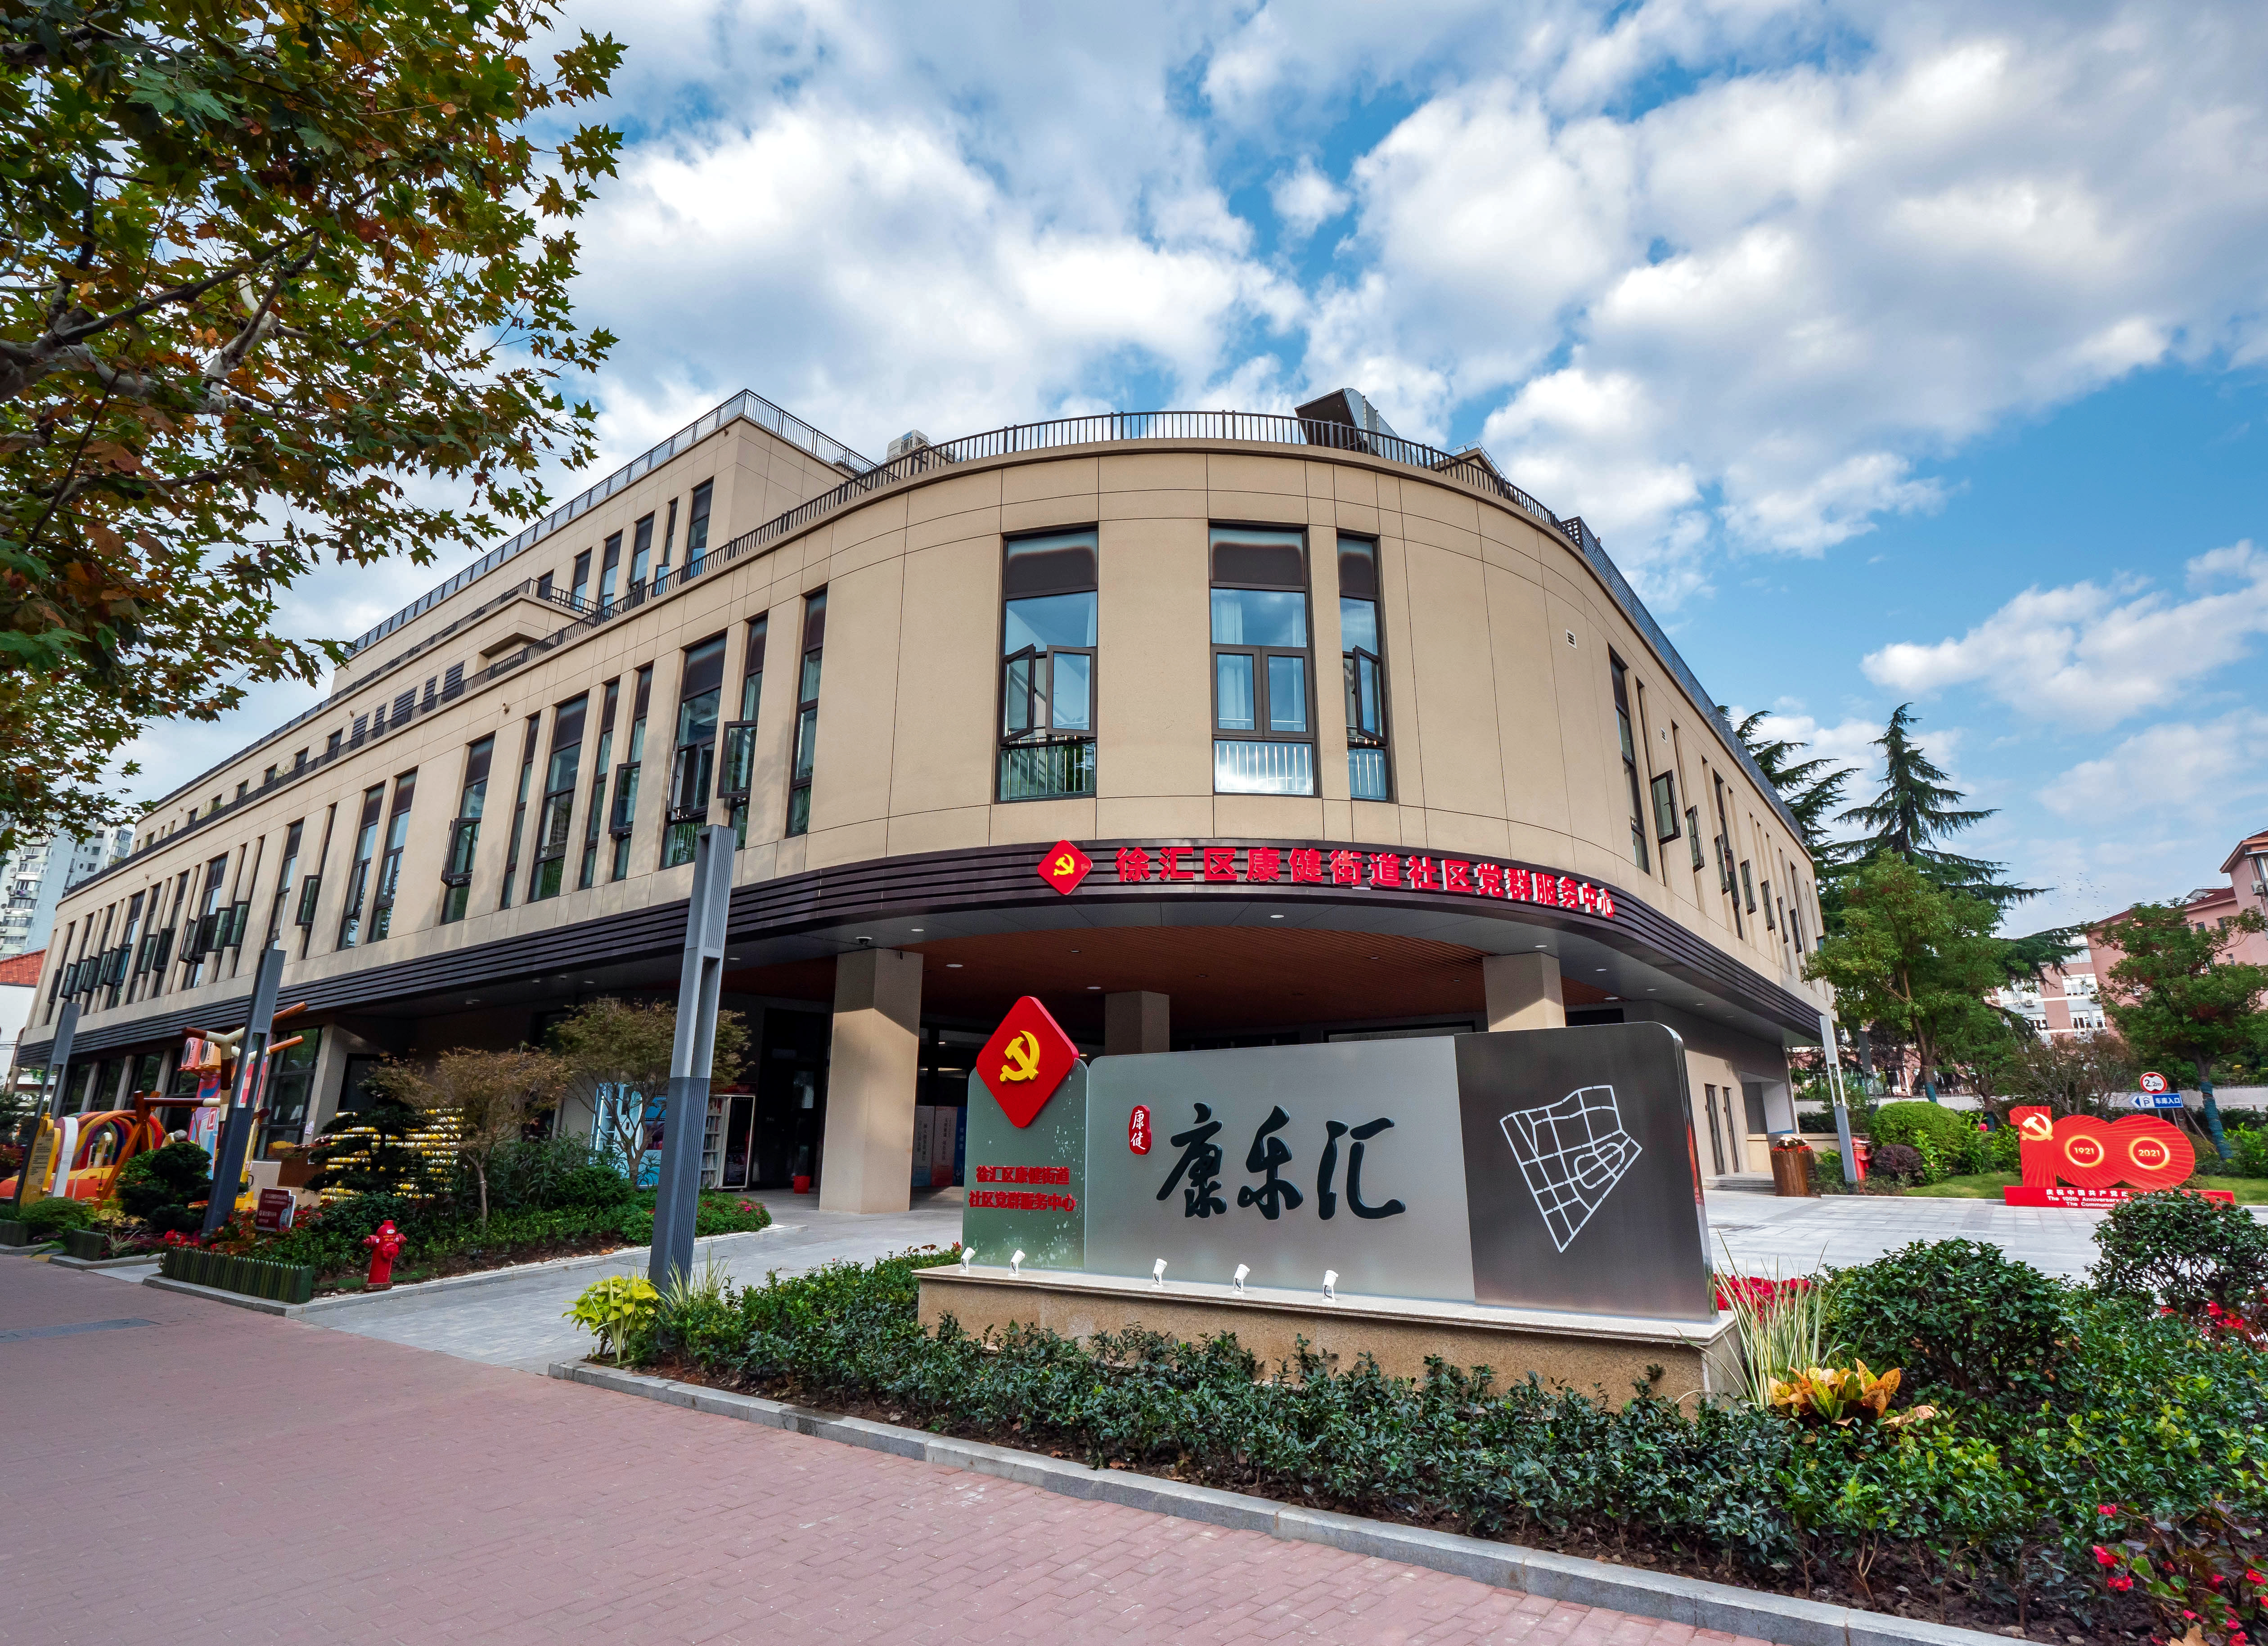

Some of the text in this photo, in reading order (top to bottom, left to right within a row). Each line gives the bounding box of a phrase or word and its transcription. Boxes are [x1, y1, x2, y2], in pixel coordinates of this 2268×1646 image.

[1115, 846, 1616, 918] 徐汇区康健街道社区党群服务中心
[2145, 1079, 2162, 1087] 2.2m
[1130, 1109, 1146, 1150] 康健
[976, 1165, 1070, 1185] 徐汇区康健街道
[1156, 1102, 1406, 1220] 康乐汇
[969, 1190, 1076, 1212] 社区党群服务中心
